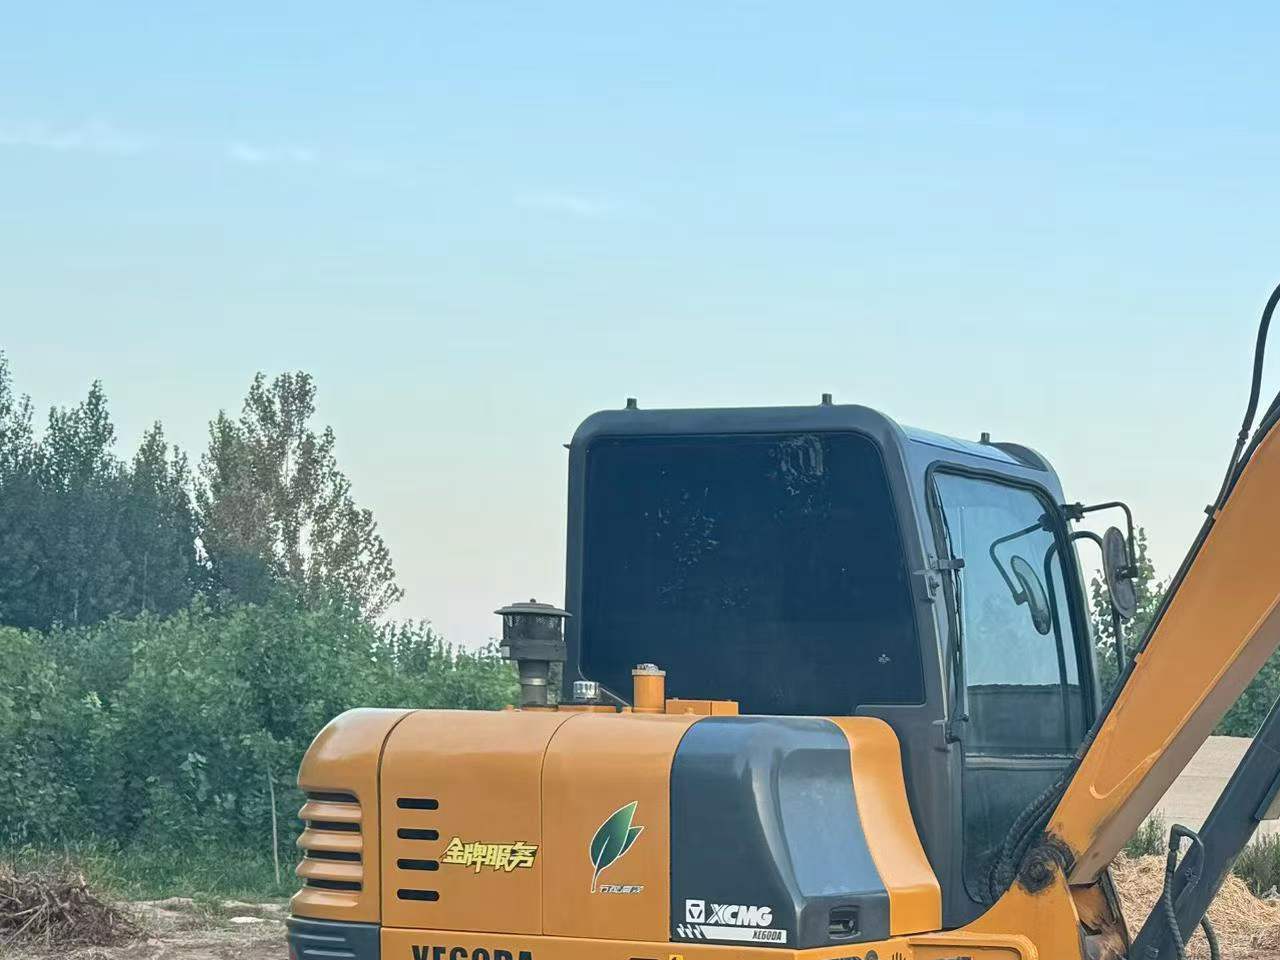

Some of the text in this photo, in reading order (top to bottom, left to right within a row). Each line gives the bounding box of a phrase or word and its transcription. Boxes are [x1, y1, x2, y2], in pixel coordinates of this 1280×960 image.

[440, 836, 539, 874] 金牌服务
[706, 903, 773, 927] XCMG
[752, 929, 783, 941] XE60DA
